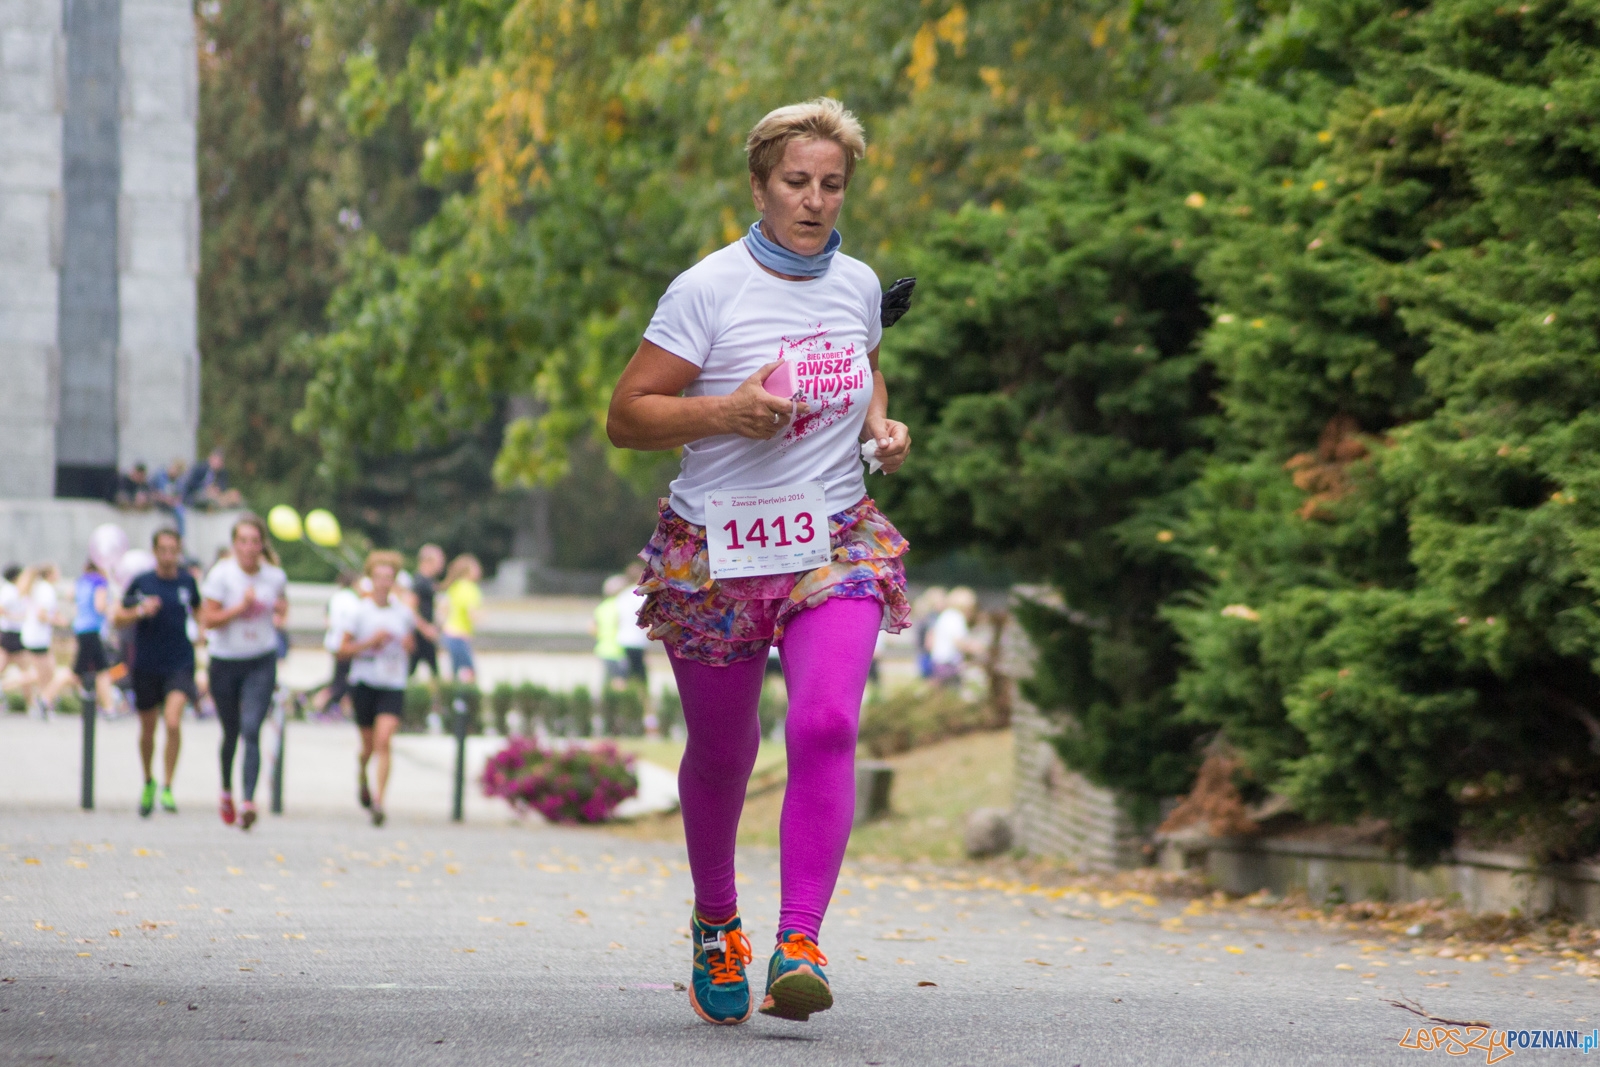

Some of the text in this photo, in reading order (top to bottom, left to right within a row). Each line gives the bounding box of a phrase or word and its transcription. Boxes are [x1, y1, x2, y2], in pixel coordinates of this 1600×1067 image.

[822, 351, 843, 359] KOBIET
[797, 358, 852, 376] awsze
[758, 496, 787, 505] Pier(w)si
[787, 493, 805, 501] 2016
[723, 511, 815, 550] 1413
